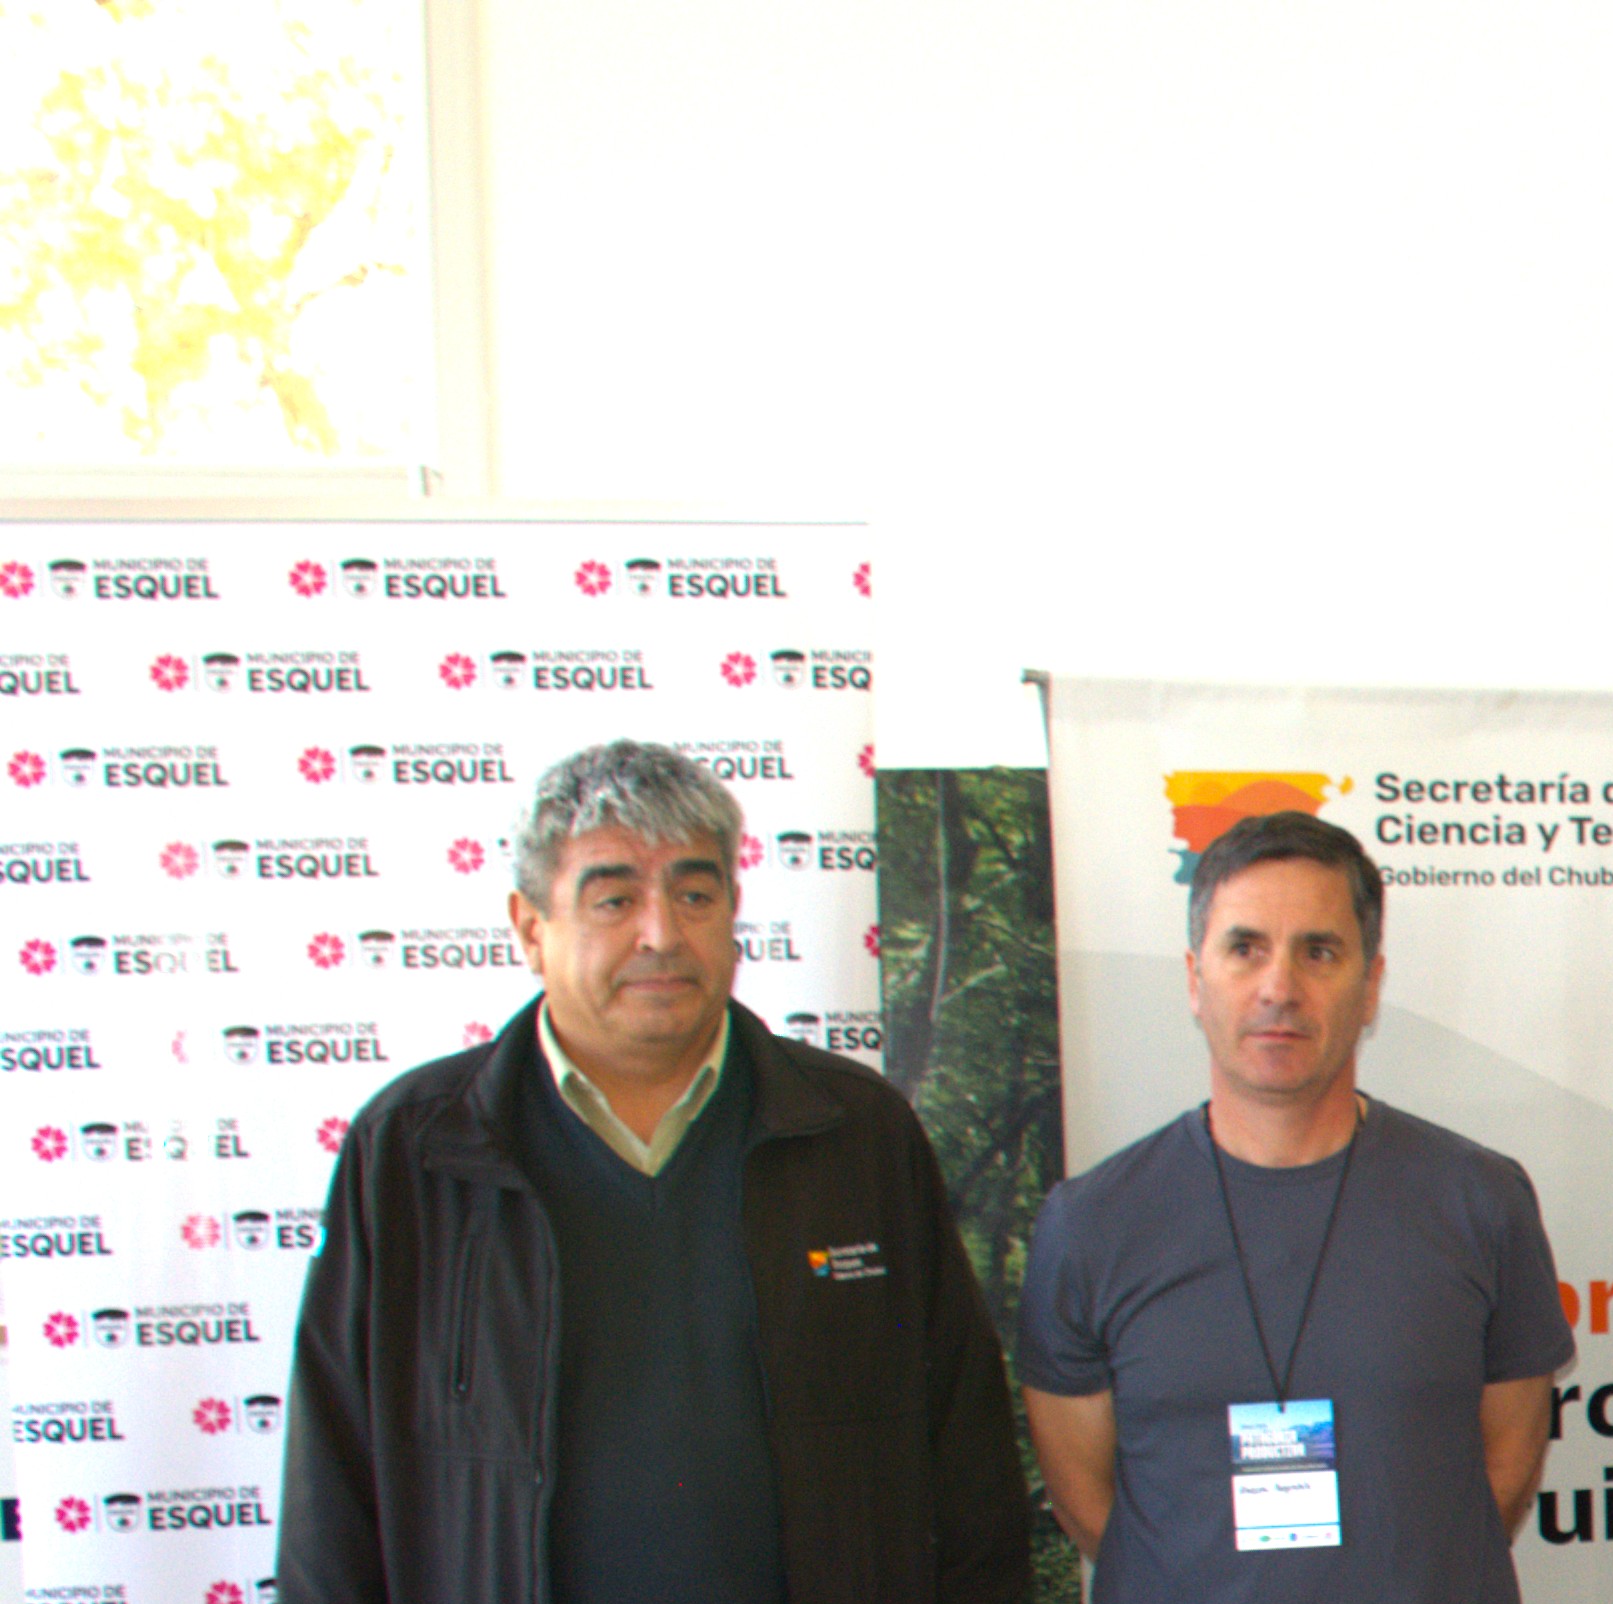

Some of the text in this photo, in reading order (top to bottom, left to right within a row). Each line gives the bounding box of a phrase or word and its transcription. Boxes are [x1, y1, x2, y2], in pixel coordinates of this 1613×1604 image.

[94, 558, 208, 571] MUNICIPIO DE
[385, 558, 496, 571] MUNICIPIO DE
[667, 558, 777, 571] MUNICIPIO DE
[94, 575, 219, 599] ESQUEL
[385, 575, 506, 598] ESQUEL
[668, 574, 786, 597] ESQUEL
[247, 651, 360, 664] MUNICIPIO DE
[247, 668, 370, 692] ESQUEL
[105, 746, 218, 759] MUNICIPIO DE
[394, 743, 504, 756] MUNICIPIO DE
[105, 763, 228, 786] ESQUEL
[394, 760, 514, 784] ESQUEL
[1375, 773, 1591, 804] Secretaría
[1375, 814, 1527, 845] Ciencia
[1535, 823, 1561, 855] y
[1379, 866, 1496, 889] Gobierno
[1501, 866, 1542, 886] del
[266, 1022, 378, 1035] MUNICIPIO DE
[266, 1039, 388, 1063] ESQUEL
[135, 1303, 249, 1318] MUNICIPIO DE
[136, 1320, 259, 1346] ESQUEL
[148, 1486, 260, 1502] MUNICIPIO DE
[148, 1503, 271, 1530] ESQUEL
